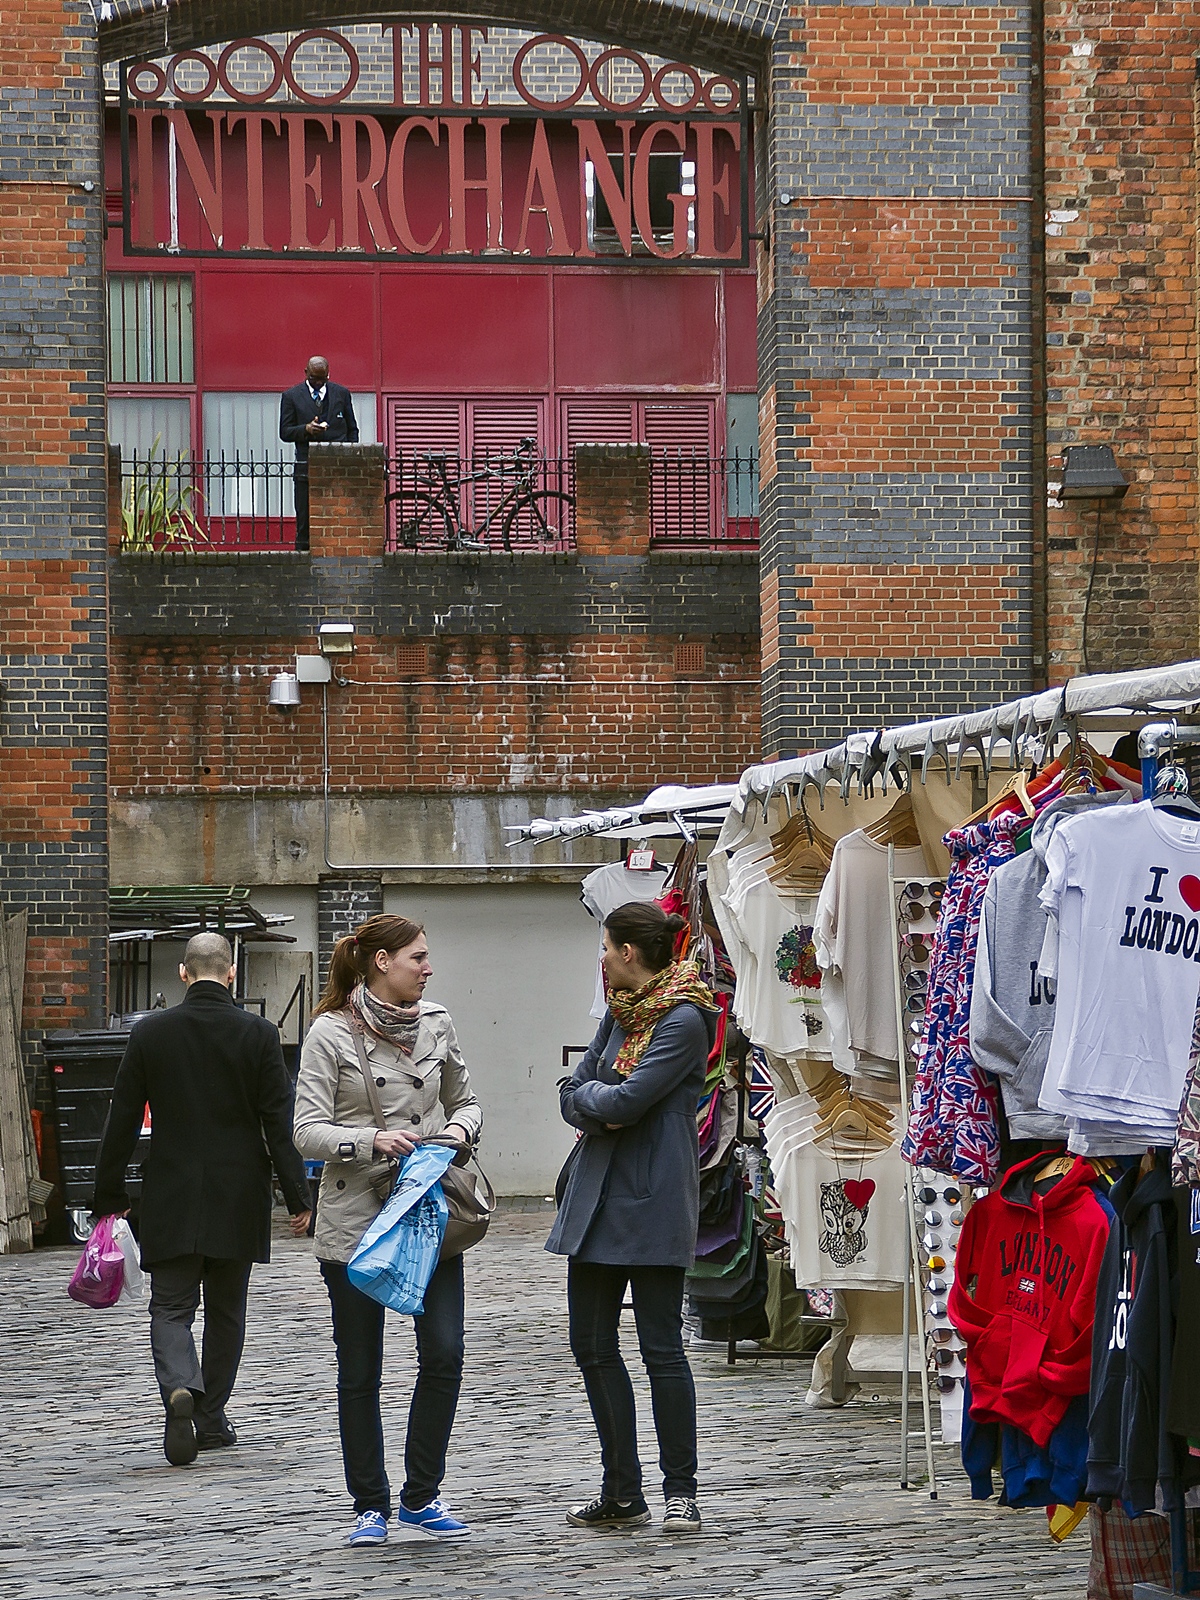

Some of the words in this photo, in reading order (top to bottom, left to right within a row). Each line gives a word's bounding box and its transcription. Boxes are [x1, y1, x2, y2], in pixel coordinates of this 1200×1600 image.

[382, 23, 489, 108] THE
[127, 107, 741, 260] INTERCHANGE
[1144, 866, 1169, 903] I
[1119, 905, 1200, 964] LONDO
